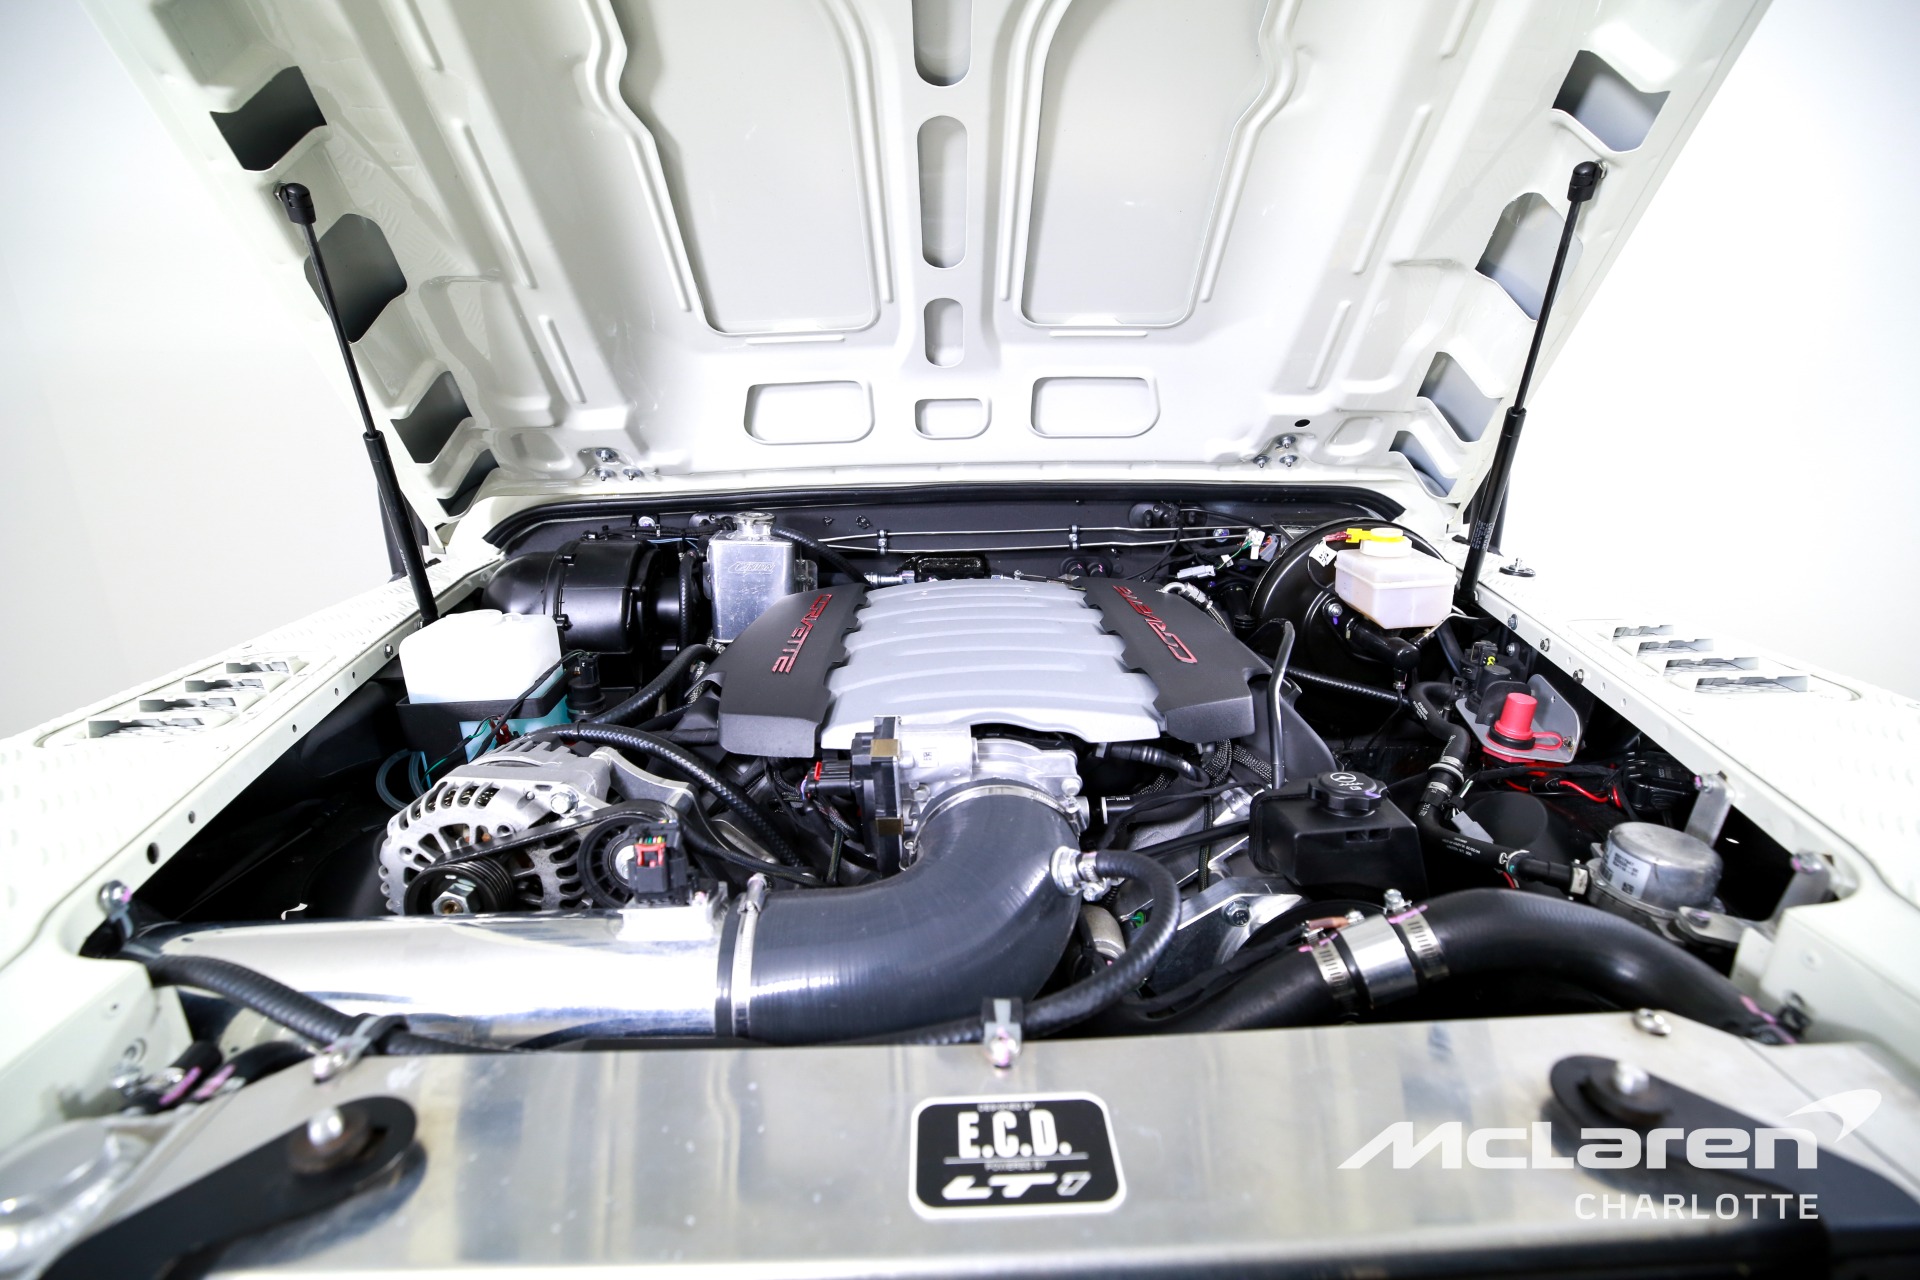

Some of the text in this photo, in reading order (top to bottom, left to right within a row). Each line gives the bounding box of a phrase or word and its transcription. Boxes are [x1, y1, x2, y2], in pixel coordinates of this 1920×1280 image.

[771, 593, 833, 674] CORVETTE
[1111, 585, 1198, 664] CORVETTE
[957, 1108, 1073, 1160] E.C.D.
